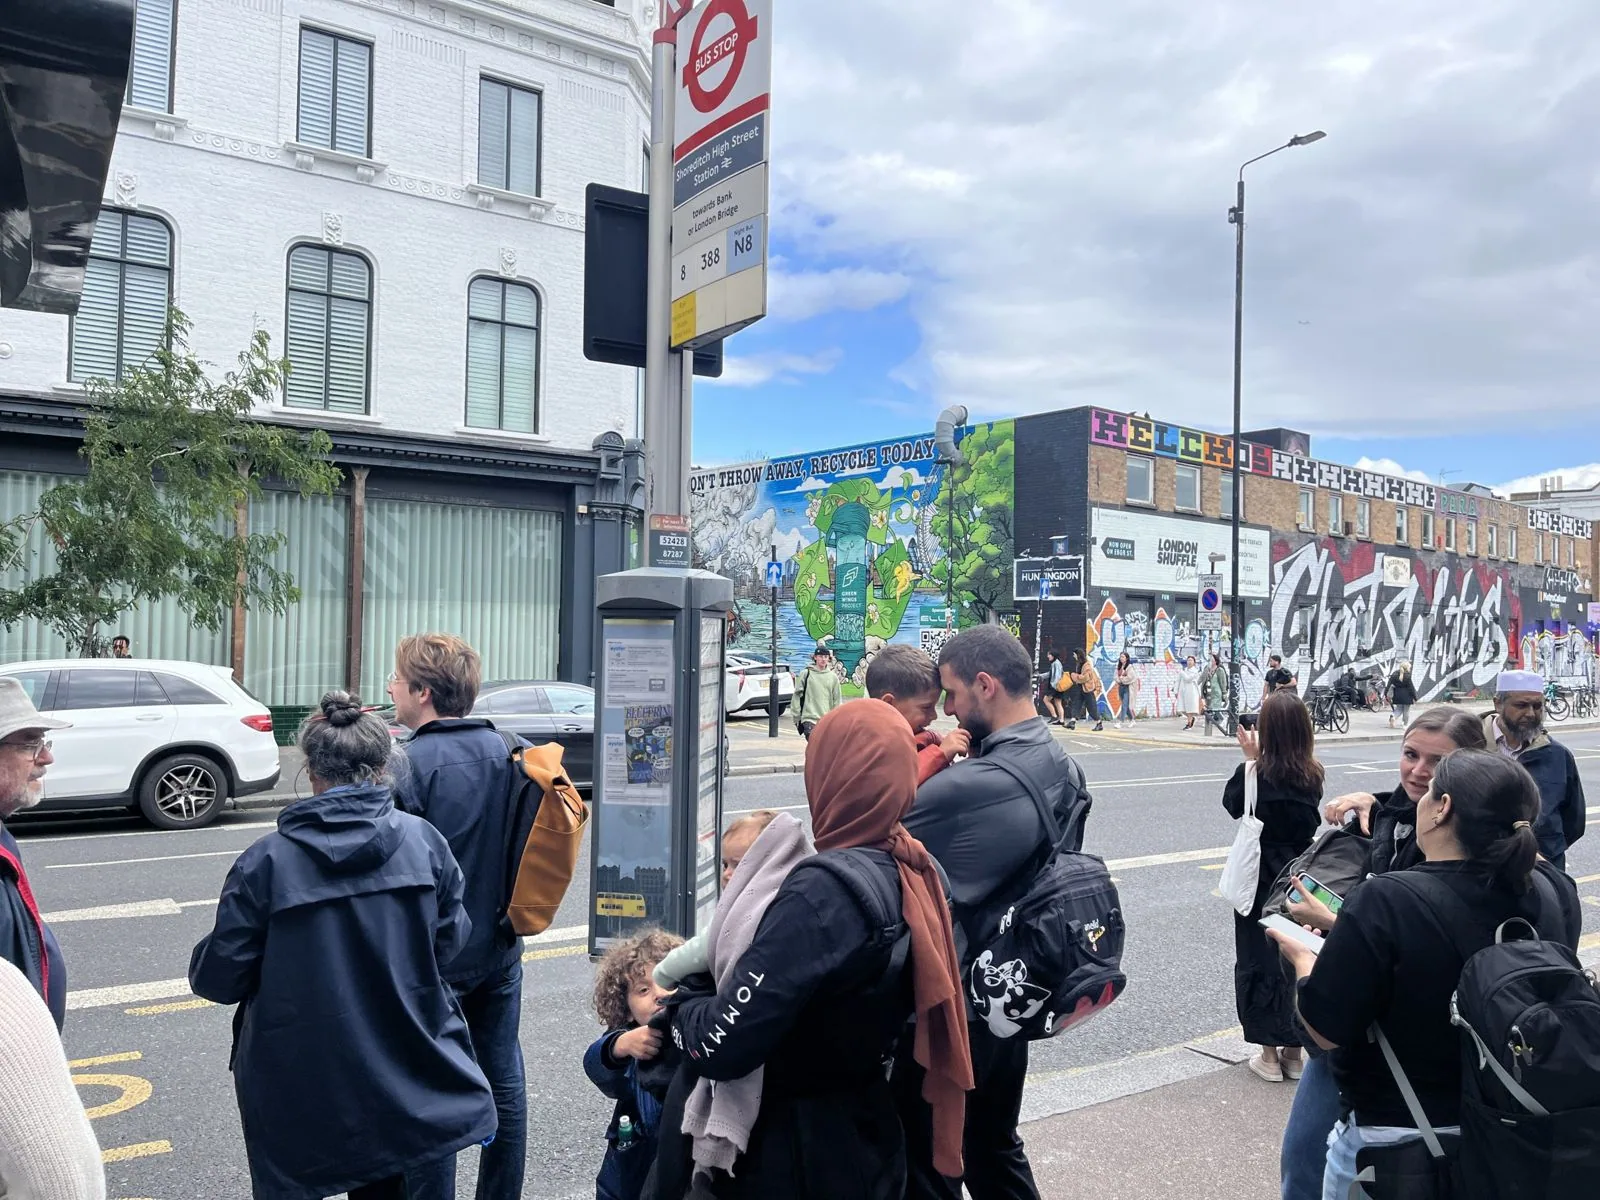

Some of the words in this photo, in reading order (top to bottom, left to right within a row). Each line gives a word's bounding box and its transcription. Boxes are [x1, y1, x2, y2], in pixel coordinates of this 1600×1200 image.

[695, 54, 712, 74] BUS
[713, 32, 739, 59] STOP
[676, 151, 711, 182] Shoreditch
[711, 140, 730, 159] High
[732, 125, 760, 148] Street
[693, 164, 719, 187] Station
[692, 198, 716, 219] towards
[716, 190, 733, 206] Bank
[687, 227, 693, 236] or
[694, 215, 717, 233] London
[717, 203, 739, 221] Bridge
[680, 264, 686, 281] 8
[701, 247, 720, 271] 388
[734, 234, 753, 257] N8
[690, 473, 716, 492] ON'T
[719, 466, 764, 488] THROW
[765, 459, 807, 482] AWAY,
[810, 447, 879, 474] RECYCLE
[881, 438, 936, 466] TODAY
[662, 537, 684, 545] 52428
[662, 550, 683, 558] 87287
[1108, 541, 1119, 549] NOW
[1157, 538, 1198, 554] LONDON
[1156, 551, 1198, 567] SHUFFLE
[701, 971, 765, 1058] TOMMY
